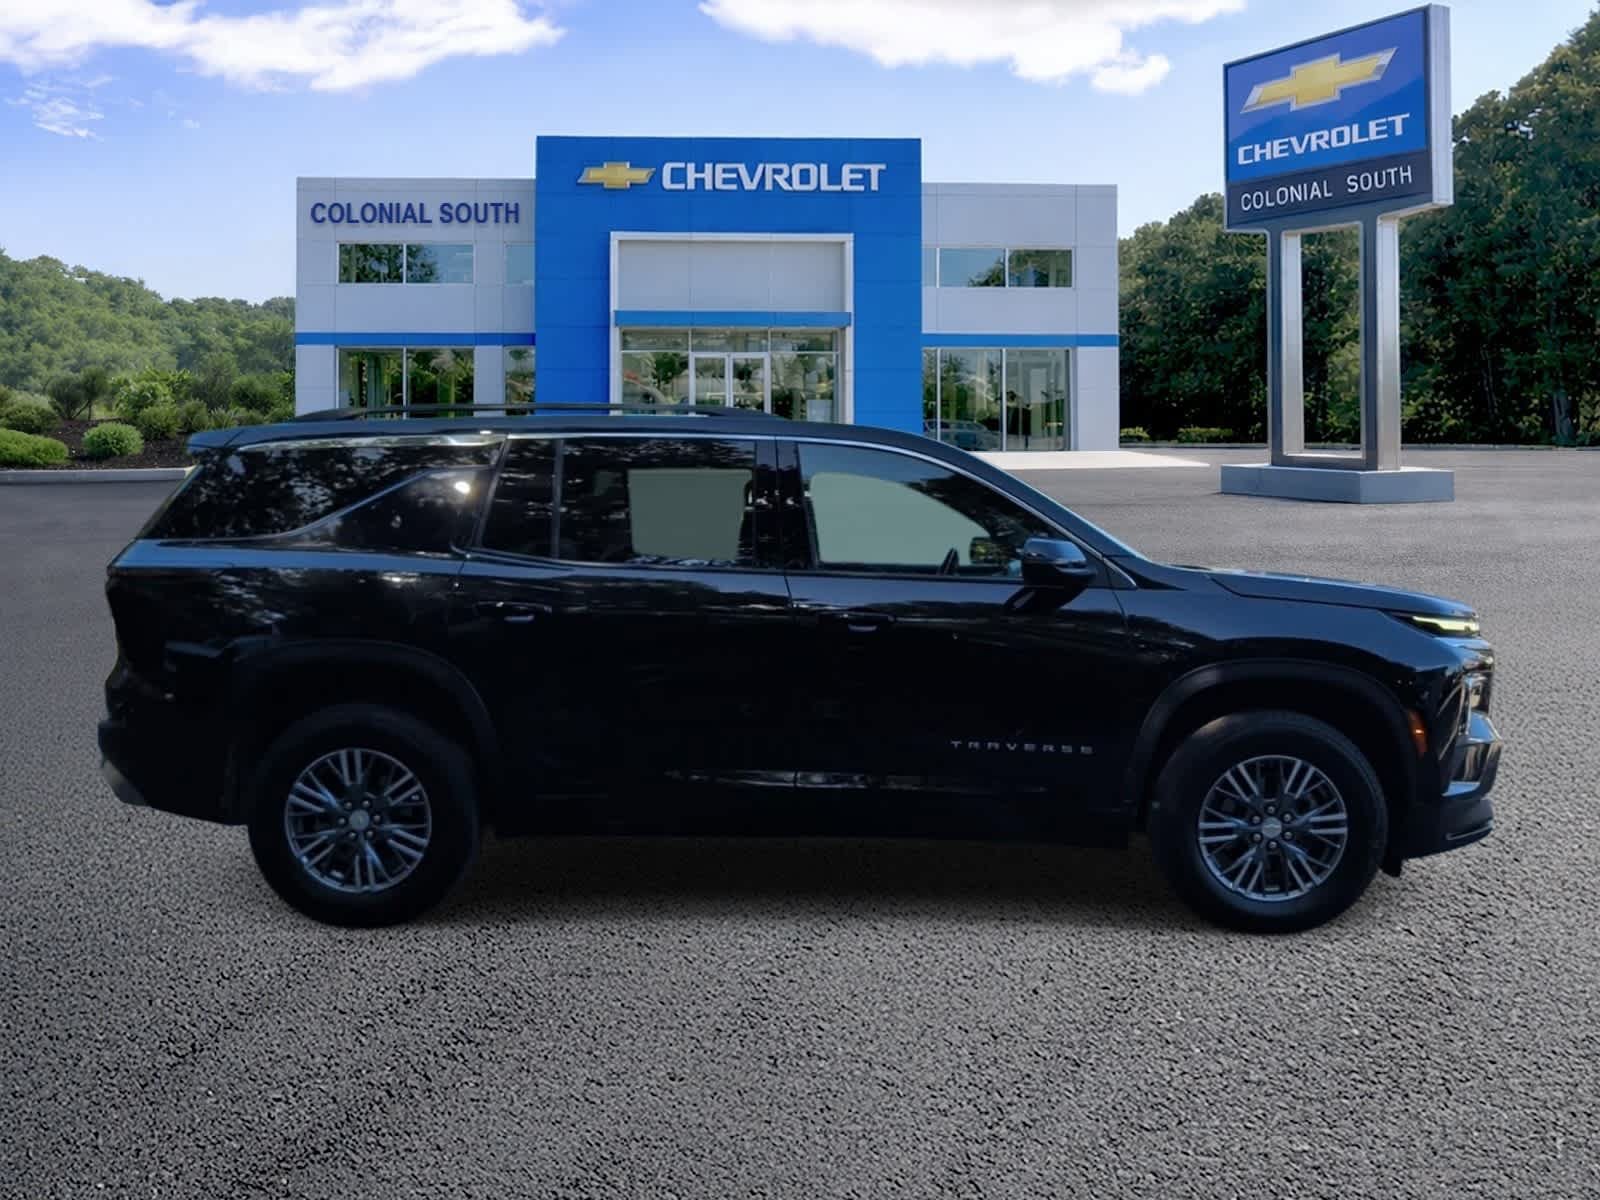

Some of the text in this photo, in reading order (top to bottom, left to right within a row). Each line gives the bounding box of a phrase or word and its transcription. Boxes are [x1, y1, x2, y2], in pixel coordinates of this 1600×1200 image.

[1237, 113, 1411, 165] CHEVROLET
[662, 162, 886, 192] CHEVROLET
[1240, 165, 1413, 211] COLONIAL SOUTH
[310, 202, 520, 225] COLONIAL SOUTH
[950, 740, 1094, 755] TRAVERSE
